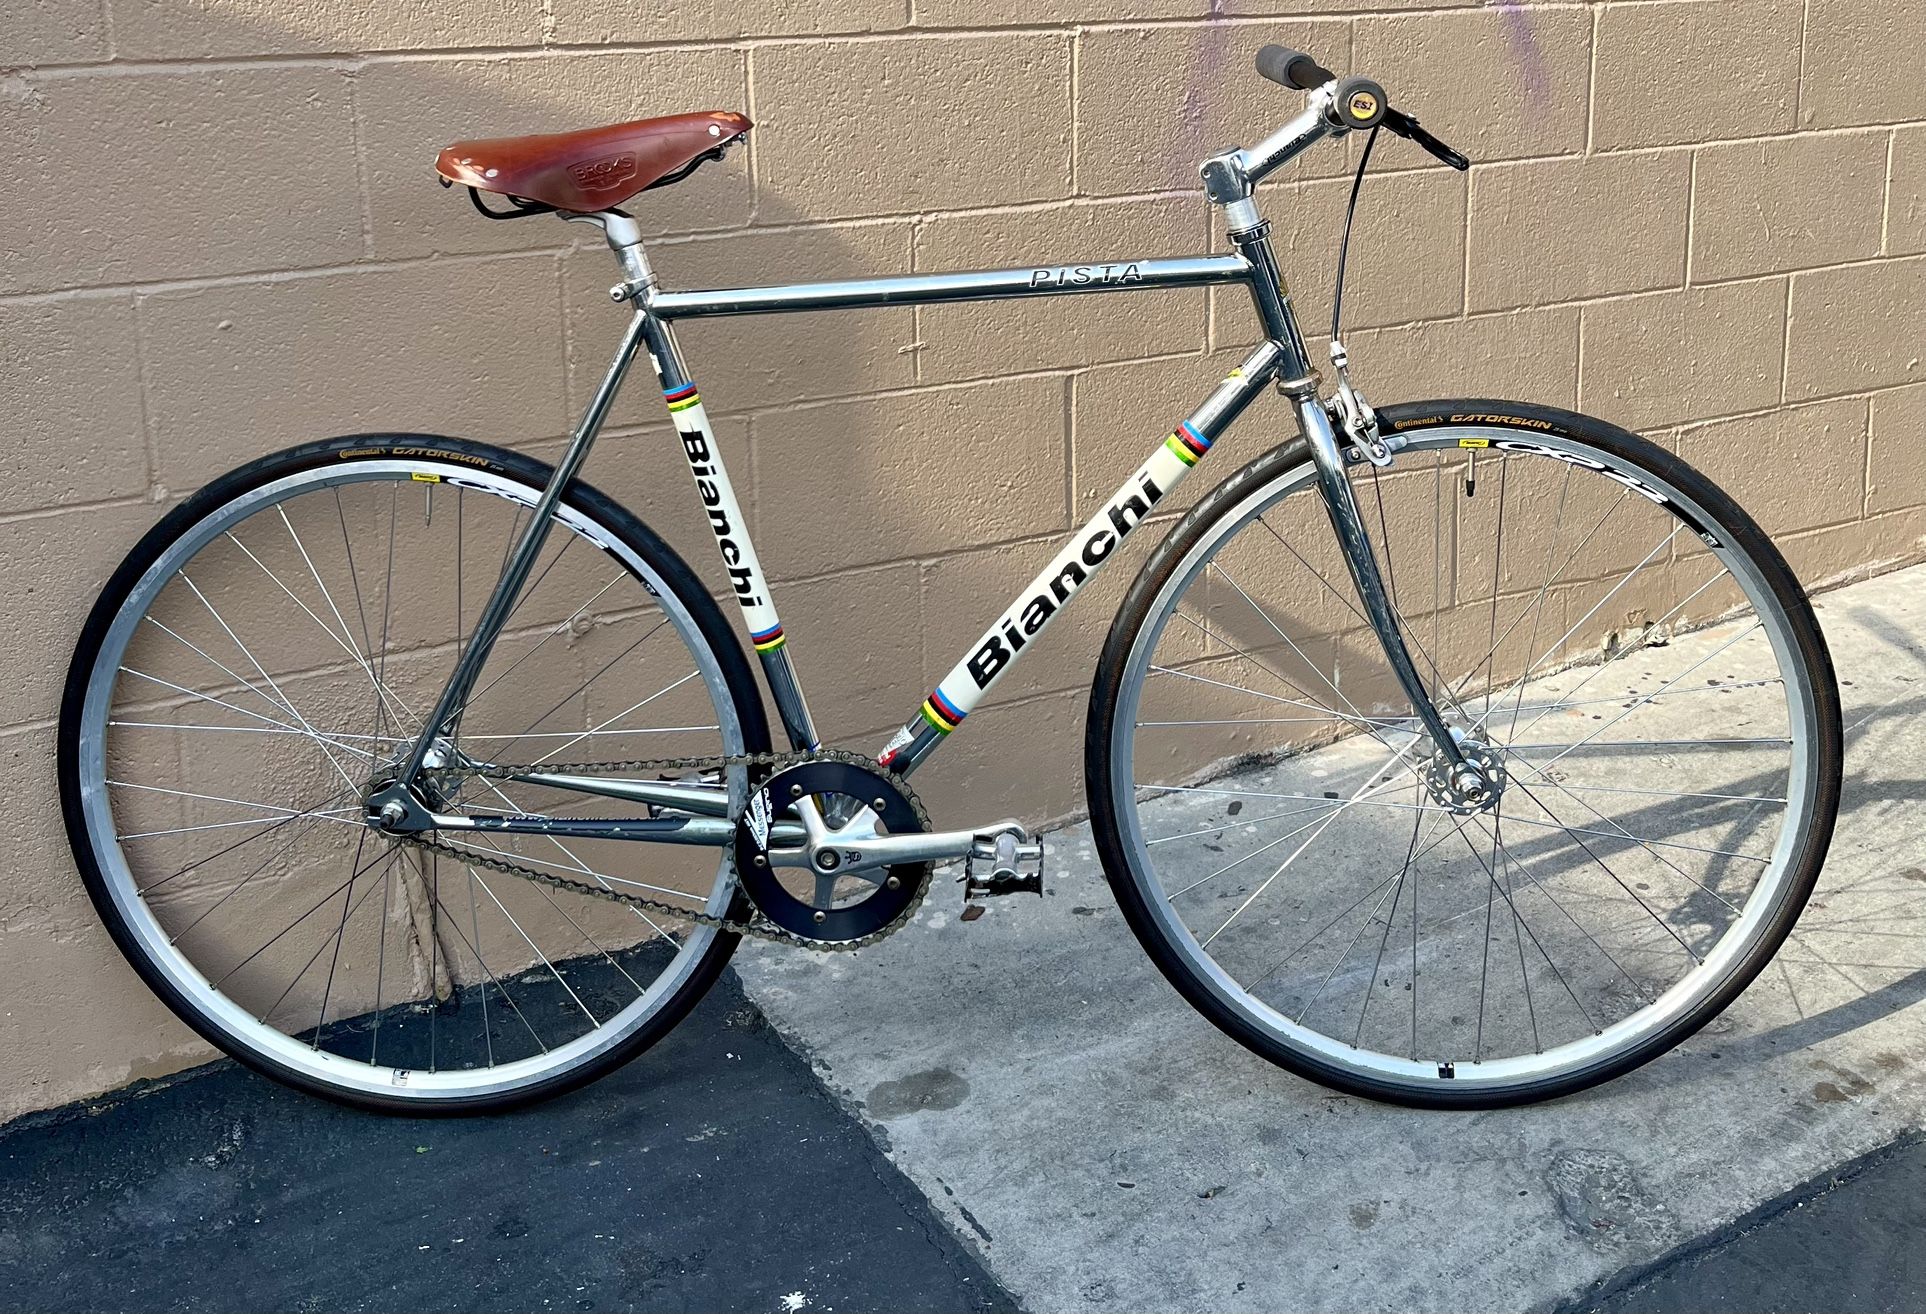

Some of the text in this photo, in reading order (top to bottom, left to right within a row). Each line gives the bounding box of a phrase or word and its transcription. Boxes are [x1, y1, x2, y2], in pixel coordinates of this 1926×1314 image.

[1353, 99, 1374, 110] ESI
[1029, 263, 1144, 288] PISTA
[1394, 414, 1553, 430] Continental GATORSKIN
[339, 447, 489, 466] Continental GATORSKIN
[679, 429, 763, 608] Bianchi
[966, 471, 1163, 691] Bianchi
